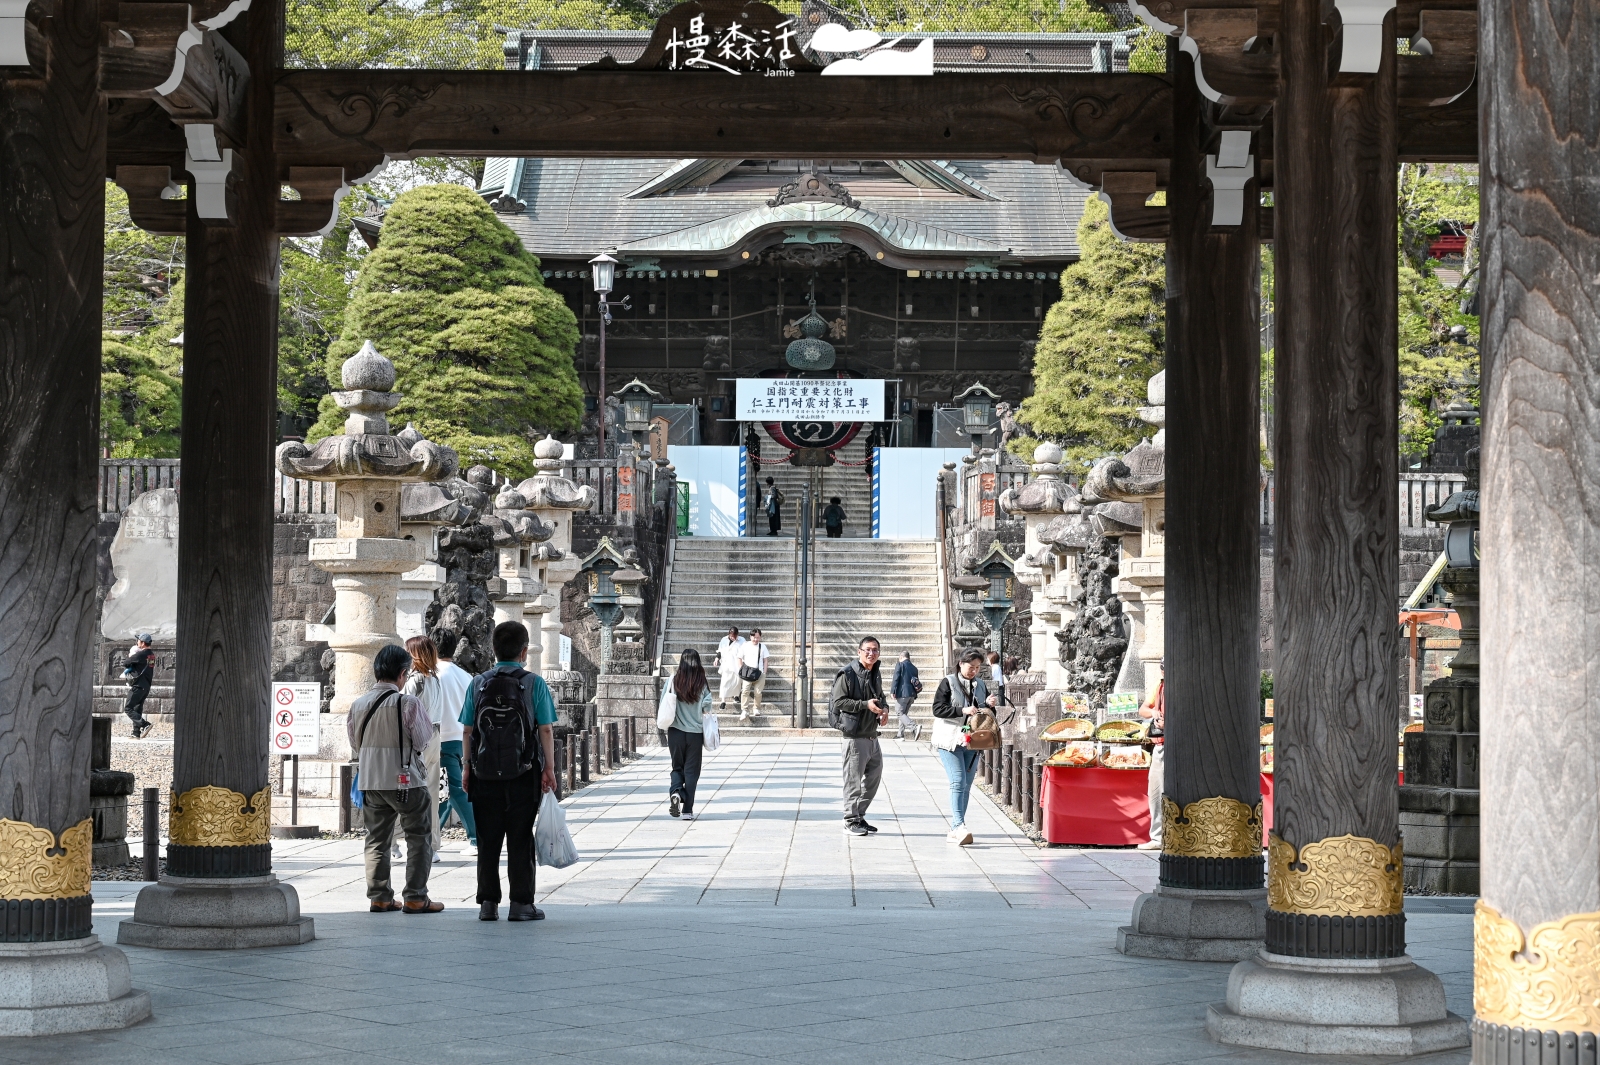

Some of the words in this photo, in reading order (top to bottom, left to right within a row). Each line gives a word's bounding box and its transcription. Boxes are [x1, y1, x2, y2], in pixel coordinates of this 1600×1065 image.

[767, 387, 853, 396] 国指定重要文化財
[752, 397, 869, 408] 仁王門耐震対策工事
